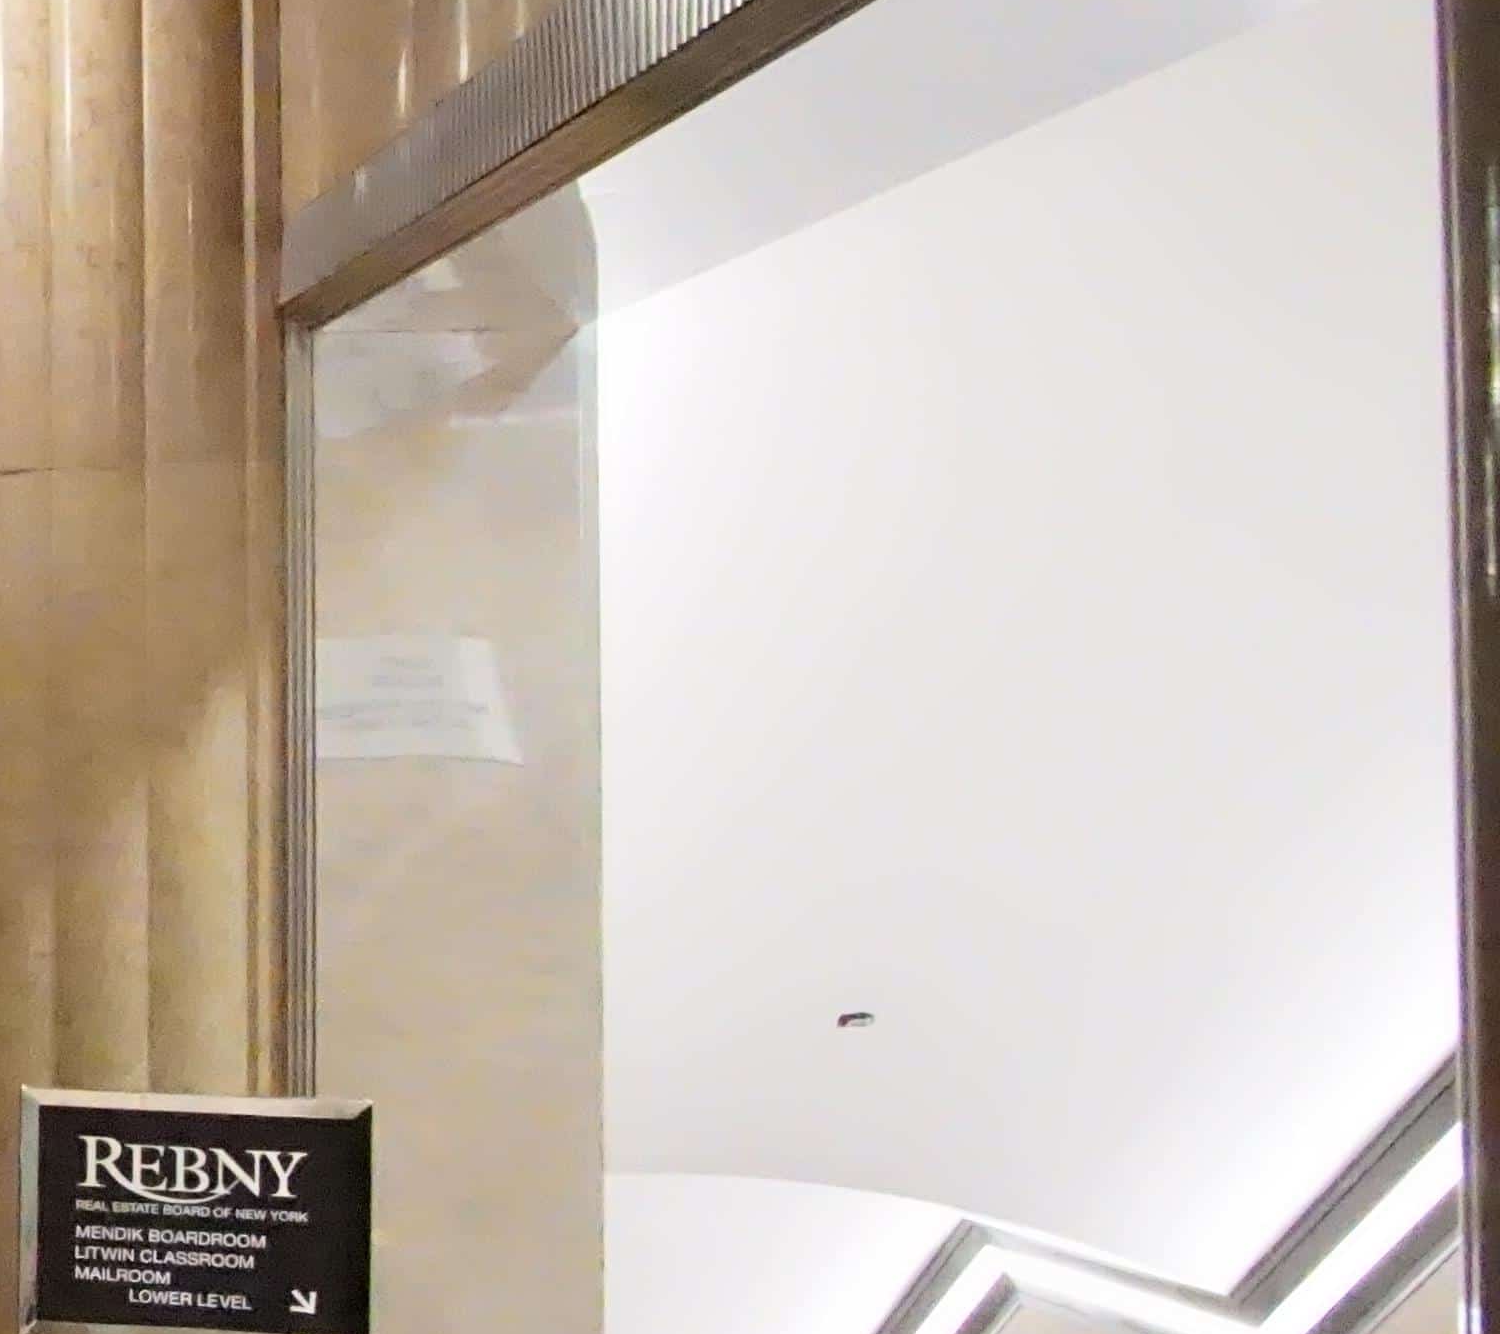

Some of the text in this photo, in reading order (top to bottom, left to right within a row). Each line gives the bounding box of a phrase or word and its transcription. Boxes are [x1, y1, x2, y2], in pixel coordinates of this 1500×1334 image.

[76, 1135, 308, 1204] REBNY
[76, 1199, 308, 1223] REAL ESTATE BOARD OF NEW YORK
[76, 1226, 266, 1248] MENDIK BOARDROOM
[75, 1246, 254, 1269] LITWIN CLASSROOM
[75, 1266, 171, 1285] MAILROOM
[129, 1289, 252, 1310] LOWER LEVEL
